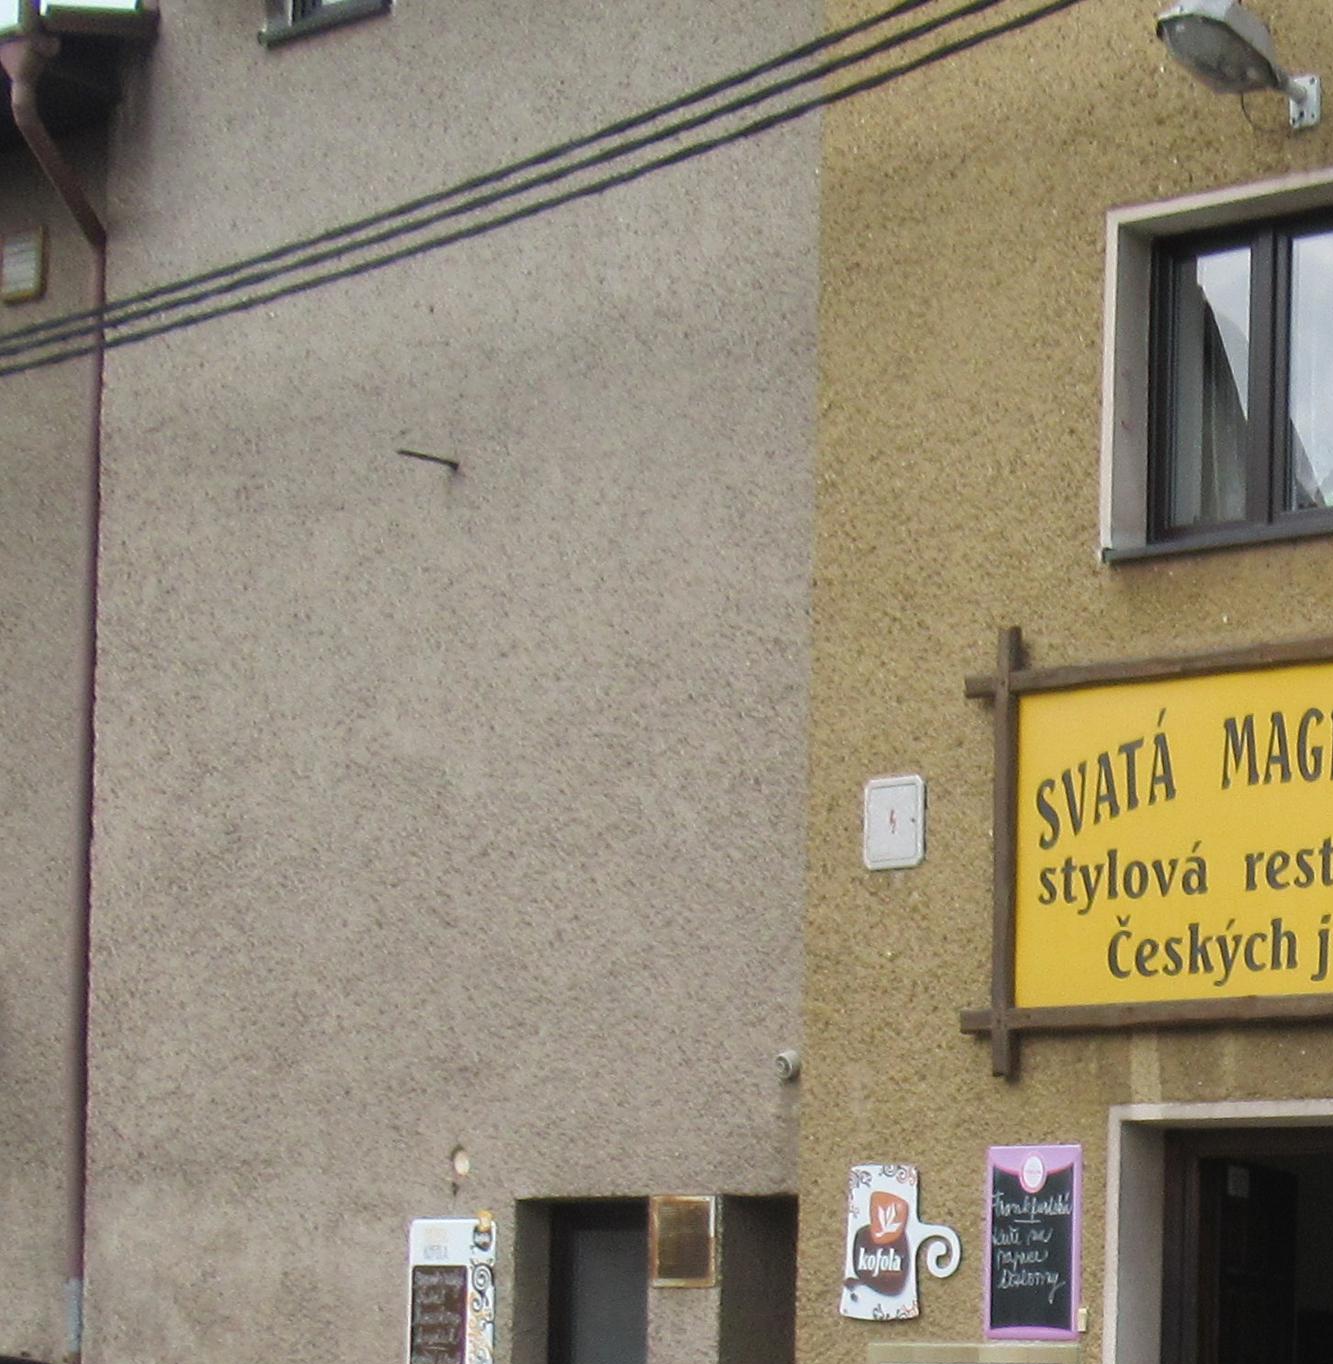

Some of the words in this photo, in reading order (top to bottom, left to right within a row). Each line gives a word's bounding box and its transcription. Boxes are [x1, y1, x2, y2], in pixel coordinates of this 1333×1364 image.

[1035, 707, 1177, 851] SVATÁ
[1038, 840, 1209, 916] stylová
[1107, 914, 1298, 988] Českých
[858, 1247, 902, 1277] kofola
